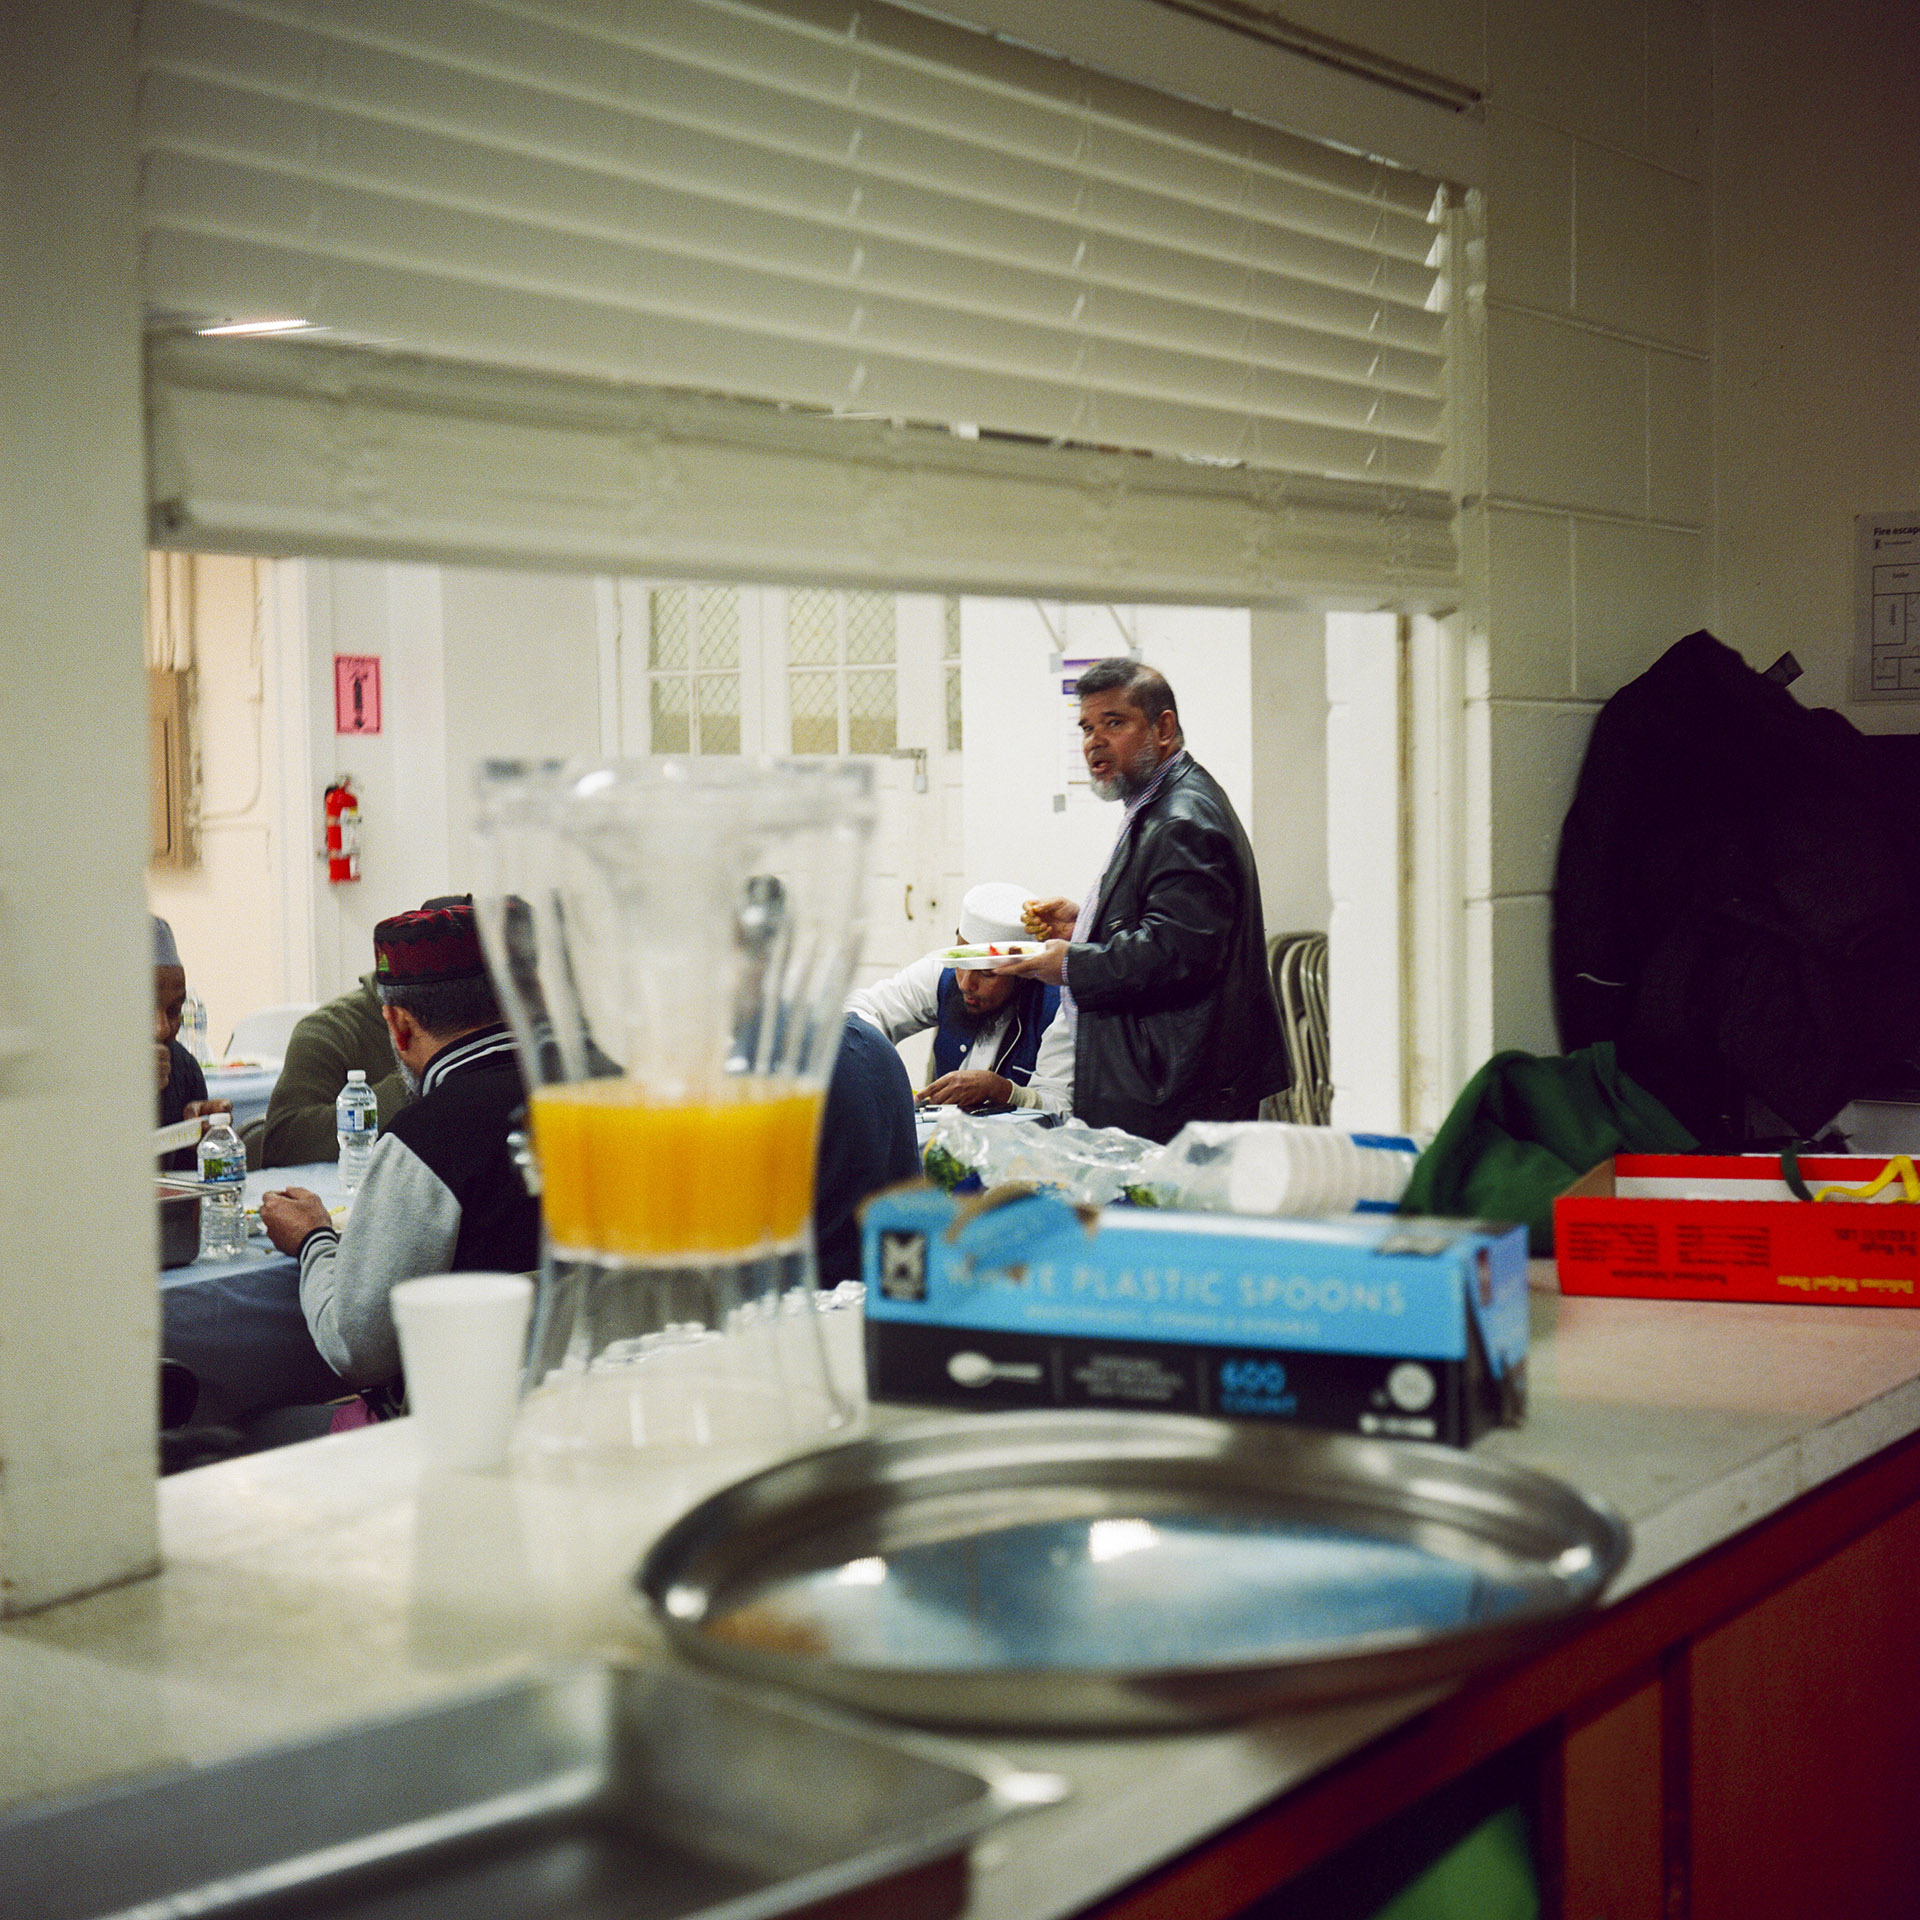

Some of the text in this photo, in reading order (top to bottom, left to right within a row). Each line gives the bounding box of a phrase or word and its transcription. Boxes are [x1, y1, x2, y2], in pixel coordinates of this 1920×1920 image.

[1873, 526, 1920, 536] Fire escap
[1073, 1262, 1222, 1307] PLASTIC
[1238, 1268, 1405, 1317] SPOONS
